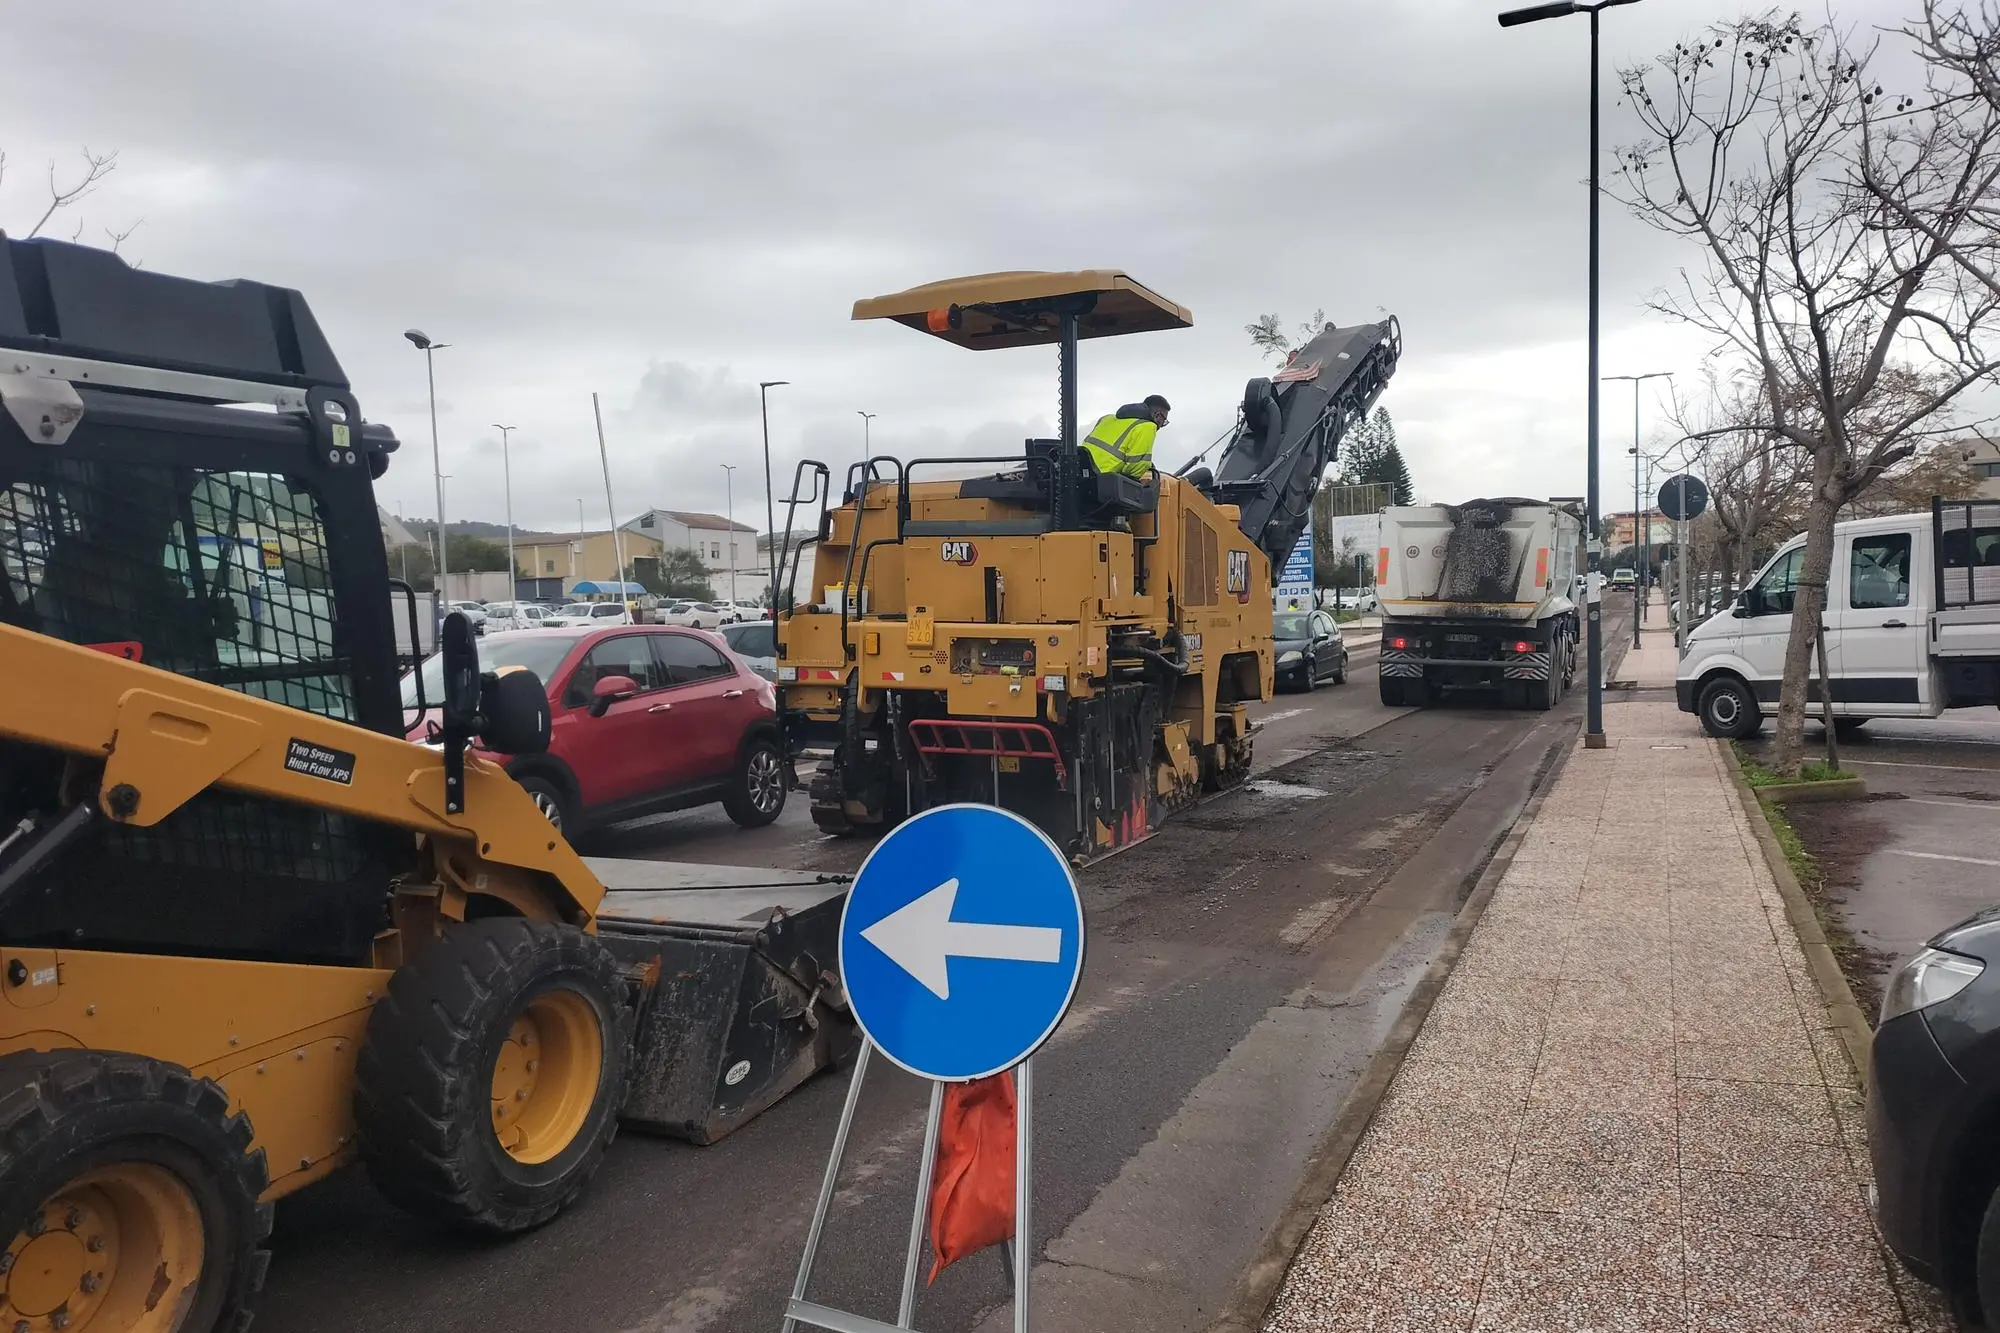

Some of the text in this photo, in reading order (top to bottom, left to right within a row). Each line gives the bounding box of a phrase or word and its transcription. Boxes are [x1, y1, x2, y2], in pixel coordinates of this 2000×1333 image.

[942, 542, 969, 560] CAT
[1228, 551, 1247, 591] CAT
[331, 767, 350, 781] XPS
